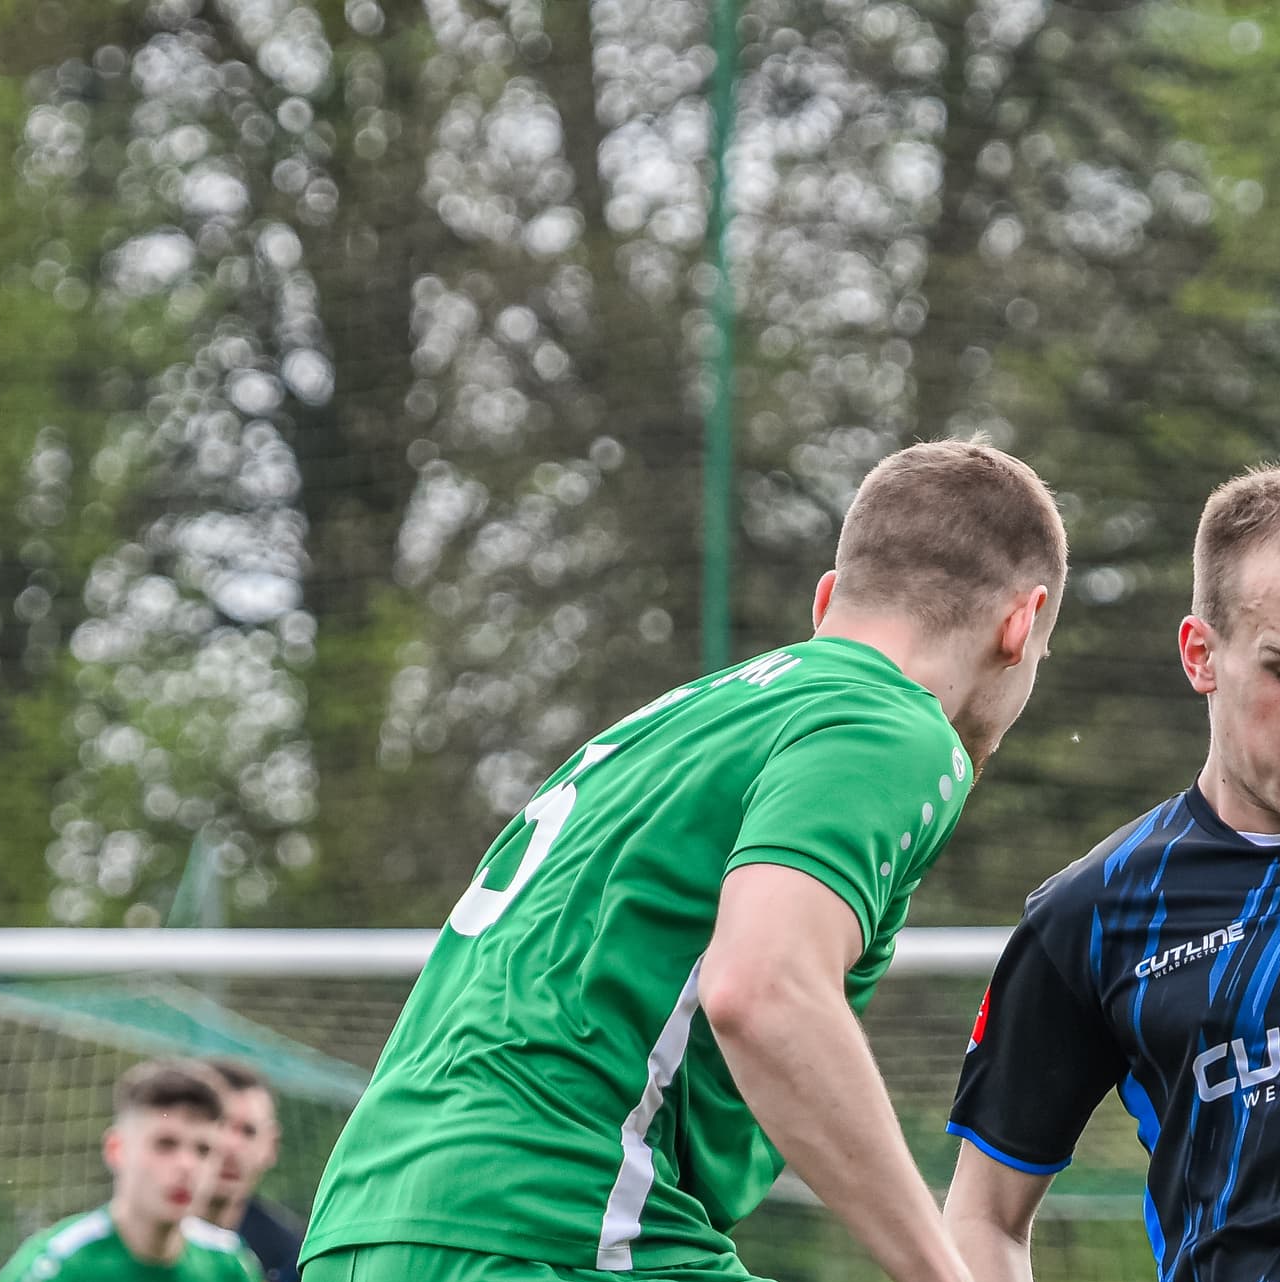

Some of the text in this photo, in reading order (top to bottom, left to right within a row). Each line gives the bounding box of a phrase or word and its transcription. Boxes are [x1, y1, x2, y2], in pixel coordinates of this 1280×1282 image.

[1135, 921, 1245, 978] CUTLINE
[1154, 944, 1232, 979] WEAR FACTORY
